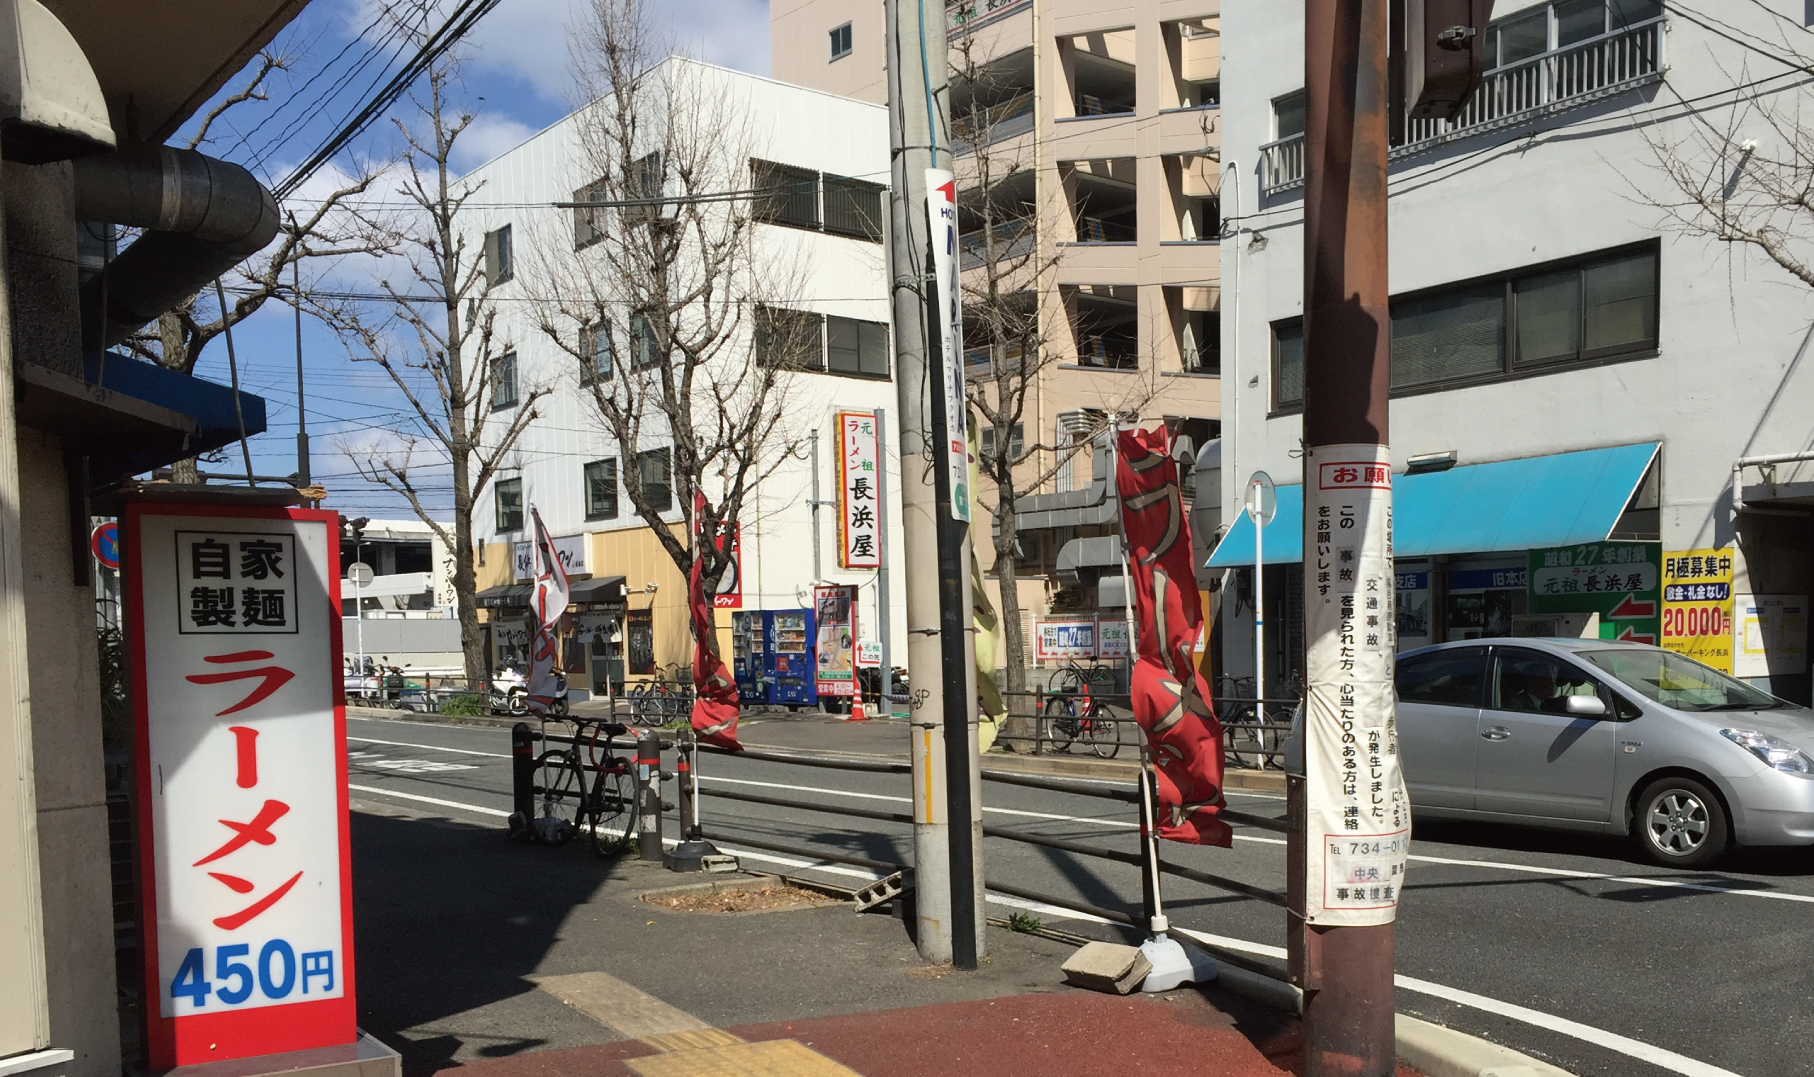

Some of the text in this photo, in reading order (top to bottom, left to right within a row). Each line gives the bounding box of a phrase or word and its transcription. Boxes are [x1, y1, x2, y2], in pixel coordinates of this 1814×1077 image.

[848, 420, 861, 471] ラーメン
[861, 421, 875, 472] 元祖
[849, 477, 876, 558] 長浜屋
[1339, 504, 1355, 530] この
[191, 540, 285, 581] 自家
[1316, 505, 1332, 604] をお願いします。
[1338, 549, 1353, 582] 事故
[1572, 566, 1608, 576] ラーメン
[1664, 554, 1731, 579] 月極募集中
[190, 587, 287, 629] 製麺
[1365, 577, 1379, 647] 交通事故
[1663, 606, 1731, 638] 20,000円
[185, 649, 303, 931] ラーメン
[1367, 730, 1384, 825] が発生しました。
[1336, 887, 1395, 901] 事故捜査
[1354, 867, 1379, 880] 中央
[170, 938, 335, 1007] 450円
